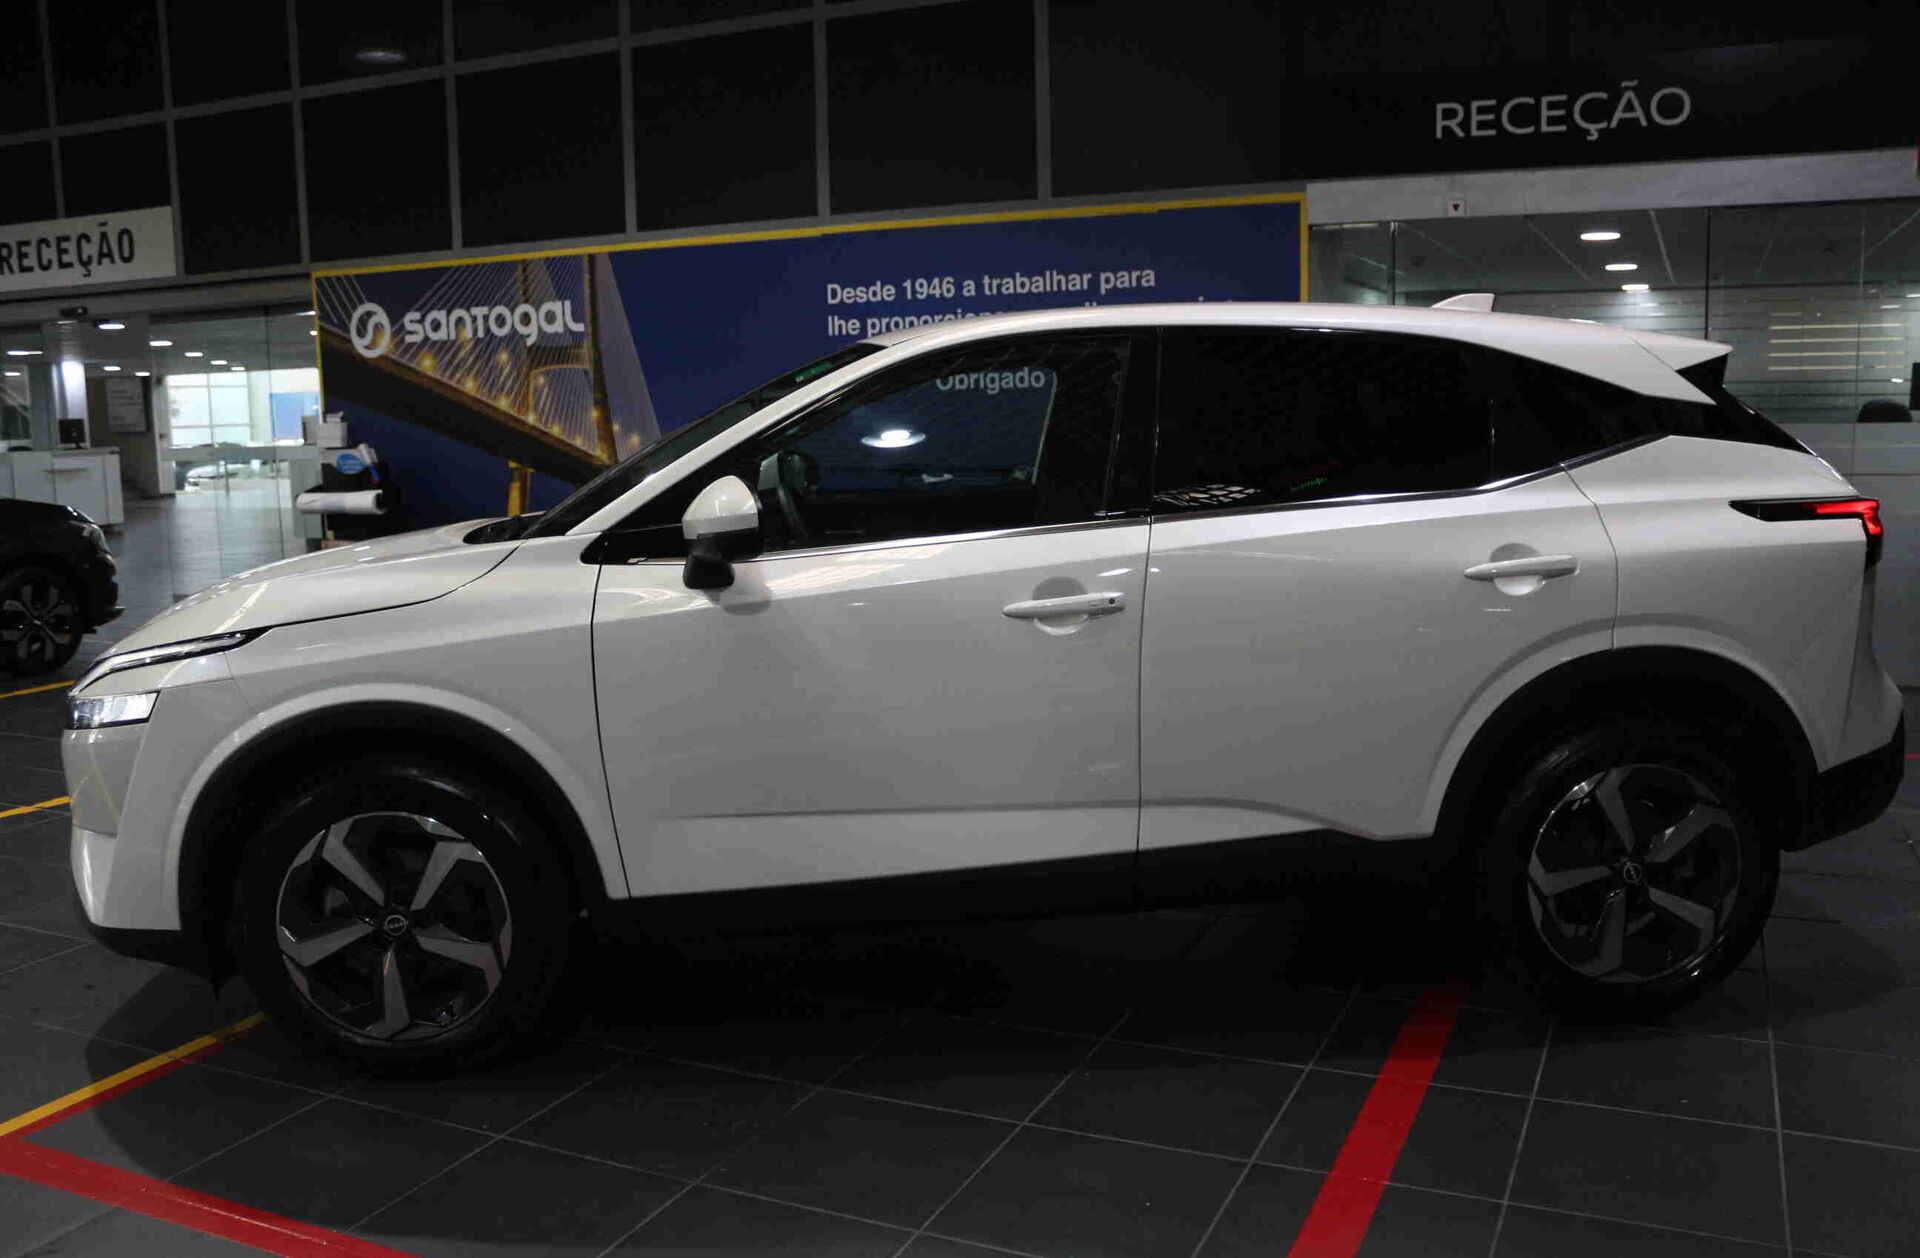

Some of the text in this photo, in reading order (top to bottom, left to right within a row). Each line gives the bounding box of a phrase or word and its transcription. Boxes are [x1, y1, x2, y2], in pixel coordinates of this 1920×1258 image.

[1435, 79, 1692, 141] RECEÇÃO
[0, 220, 135, 277] RECEÇÃO
[827, 269, 1156, 305] Desde 1946 a trabalhar para
[828, 315, 861, 337] lhe
